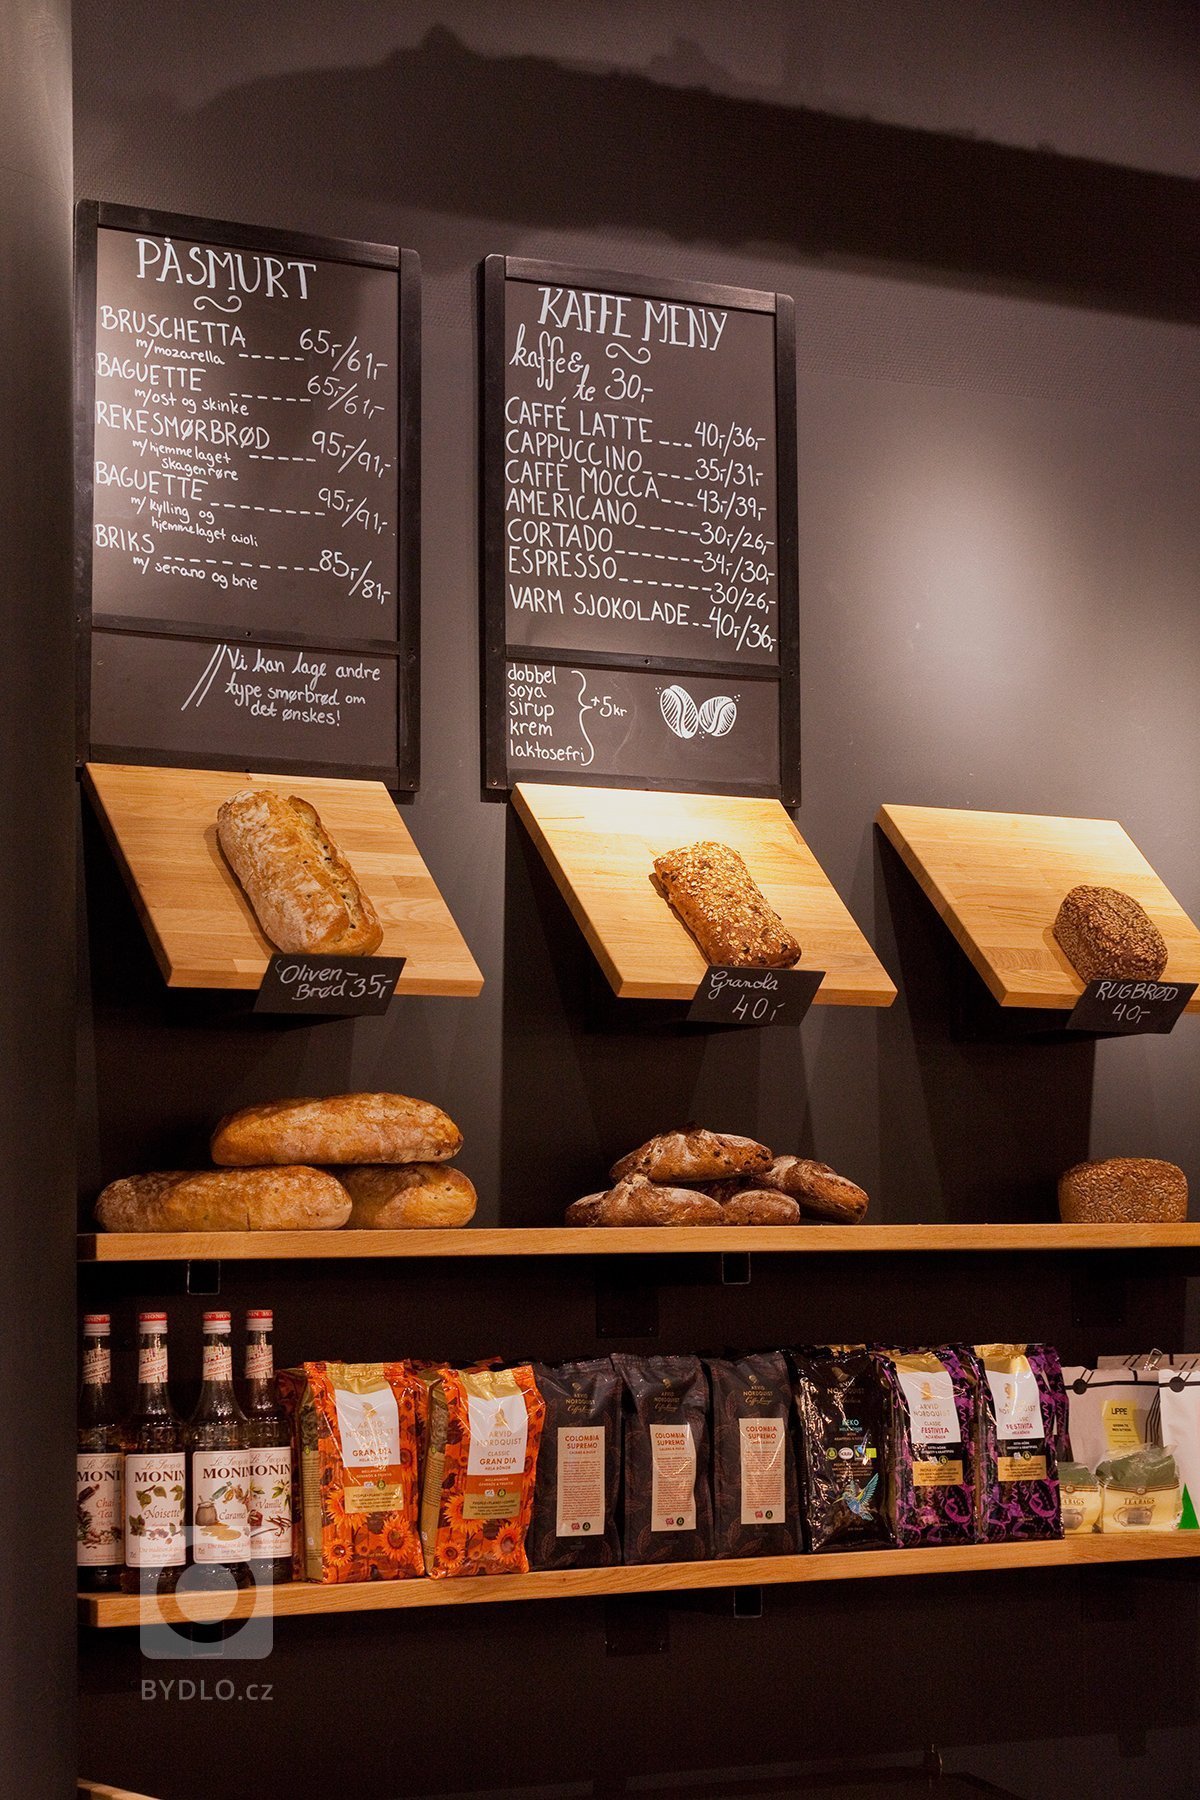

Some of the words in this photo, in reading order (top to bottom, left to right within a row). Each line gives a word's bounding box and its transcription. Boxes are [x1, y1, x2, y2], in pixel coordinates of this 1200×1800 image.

[136, 237, 317, 299] PÅSMURT
[100, 305, 246, 348] BRUSCHETTA
[537, 287, 631, 338] KAFFE
[642, 301, 727, 351] MENY
[97, 352, 206, 391] BAGUETTE
[572, 364, 596, 402] te
[182, 398, 197, 414] og
[202, 398, 249, 416] skinke
[95, 401, 270, 449] REKESMØRBRØD
[580, 410, 653, 443] LATTE
[506, 429, 643, 473] CAPPUCCINO
[95, 461, 208, 501] BAGUETTE
[581, 467, 659, 499] MOCCA
[198, 510, 215, 525] og
[506, 488, 637, 526] AMERICANO
[95, 524, 155, 553] BRIKS
[151, 516, 226, 543] hjemmelaget
[231, 532, 258, 547] aioli
[507, 518, 613, 552] CORTADO
[155, 561, 206, 580] serano
[212, 574, 228, 589] og
[232, 576, 258, 590] brie
[508, 546, 617, 579] ESPRESSO
[509, 584, 564, 614] VARM
[573, 592, 690, 626] SJOKOLADE
[227, 648, 248, 671] Vi
[254, 649, 285, 674] kan
[291, 651, 327, 690] lage
[336, 665, 381, 681] andre
[508, 664, 557, 685] dobbel
[225, 671, 263, 707] type
[267, 685, 340, 708] smørbrød
[345, 695, 366, 705] om
[508, 683, 547, 698] soya
[250, 699, 277, 717] det
[282, 708, 341, 727] ønskes!
[509, 699, 555, 720] sirup
[510, 718, 553, 737] krem
[510, 740, 585, 762] laktosefri
[708, 970, 779, 1000] Granola
[1095, 981, 1179, 1002] RUGBRØD
[564, 1434, 600, 1442] COLOMBIA
[77, 1470, 121, 1482] MONI
[479, 1458, 503, 1466] GRAN
[504, 1457, 517, 1465] DIA
